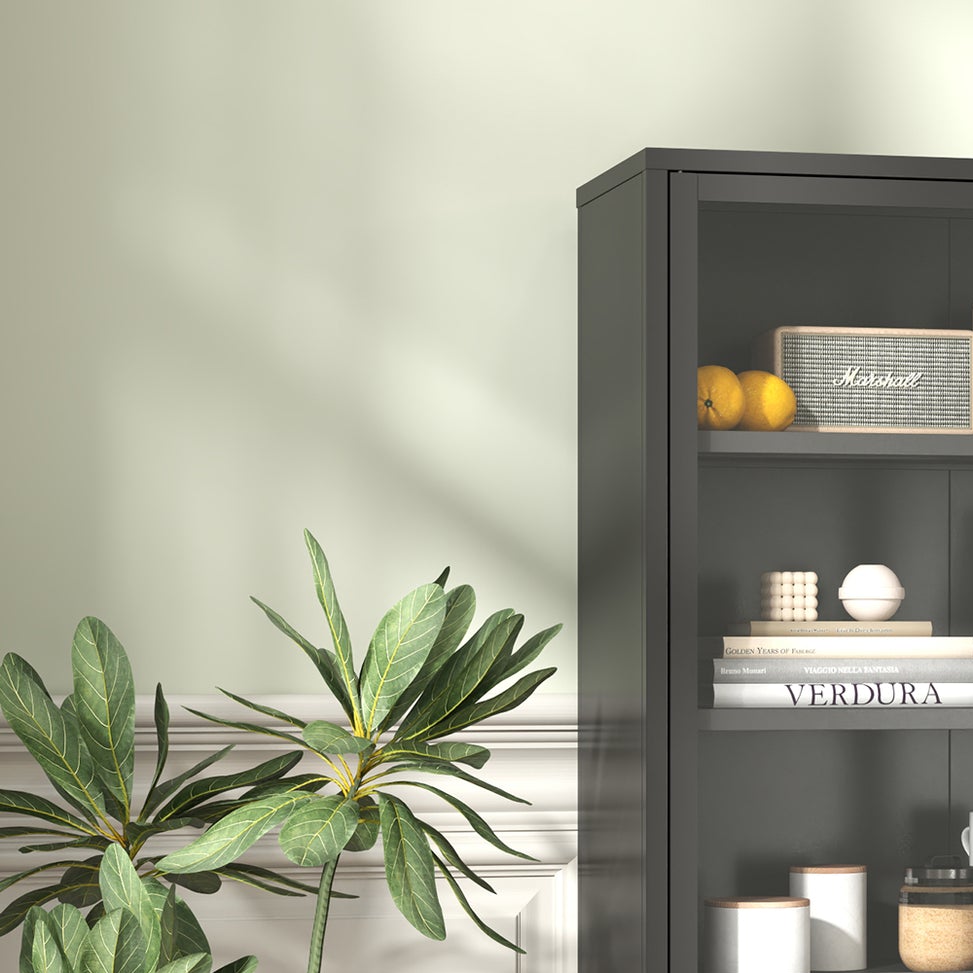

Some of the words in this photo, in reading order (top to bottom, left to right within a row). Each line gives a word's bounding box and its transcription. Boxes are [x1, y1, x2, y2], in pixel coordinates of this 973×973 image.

[833, 366, 924, 388] Marshall
[804, 666, 837, 674] VIAGGIO
[863, 666, 900, 674] FANTASIA
[784, 682, 943, 706] VERDURA
